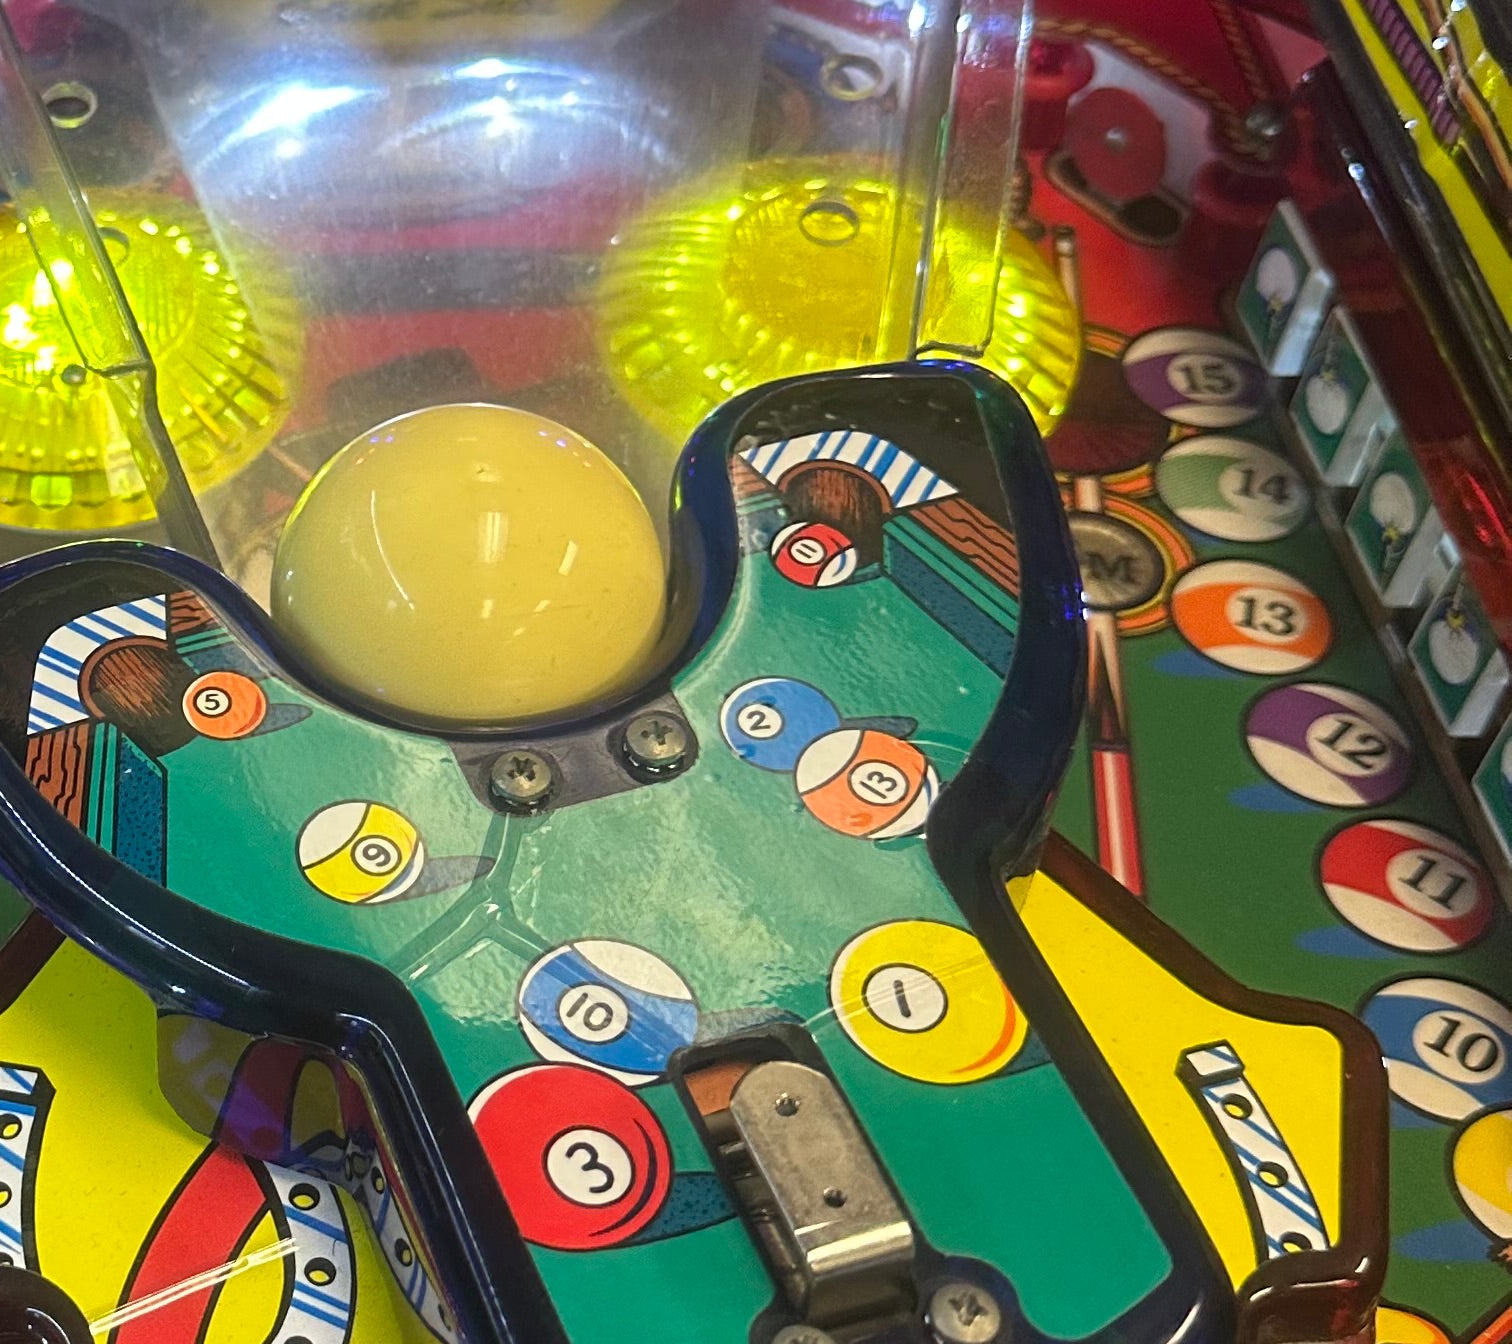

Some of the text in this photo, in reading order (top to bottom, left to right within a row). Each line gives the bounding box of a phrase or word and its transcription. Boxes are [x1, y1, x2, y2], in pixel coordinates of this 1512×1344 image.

[1178, 363, 1233, 396] 15
[1233, 466, 1289, 506] 14
[1235, 596, 1298, 636] 13
[203, 693, 220, 711] 5
[748, 710, 770, 731] 2
[1317, 720, 1388, 769] 12
[860, 769, 898, 798] 13
[1399, 855, 1468, 911] 11
[565, 991, 615, 1032] 10
[892, 978, 911, 1018] 1
[1423, 1016, 1500, 1073] 10
[566, 1140, 614, 1193] 3
